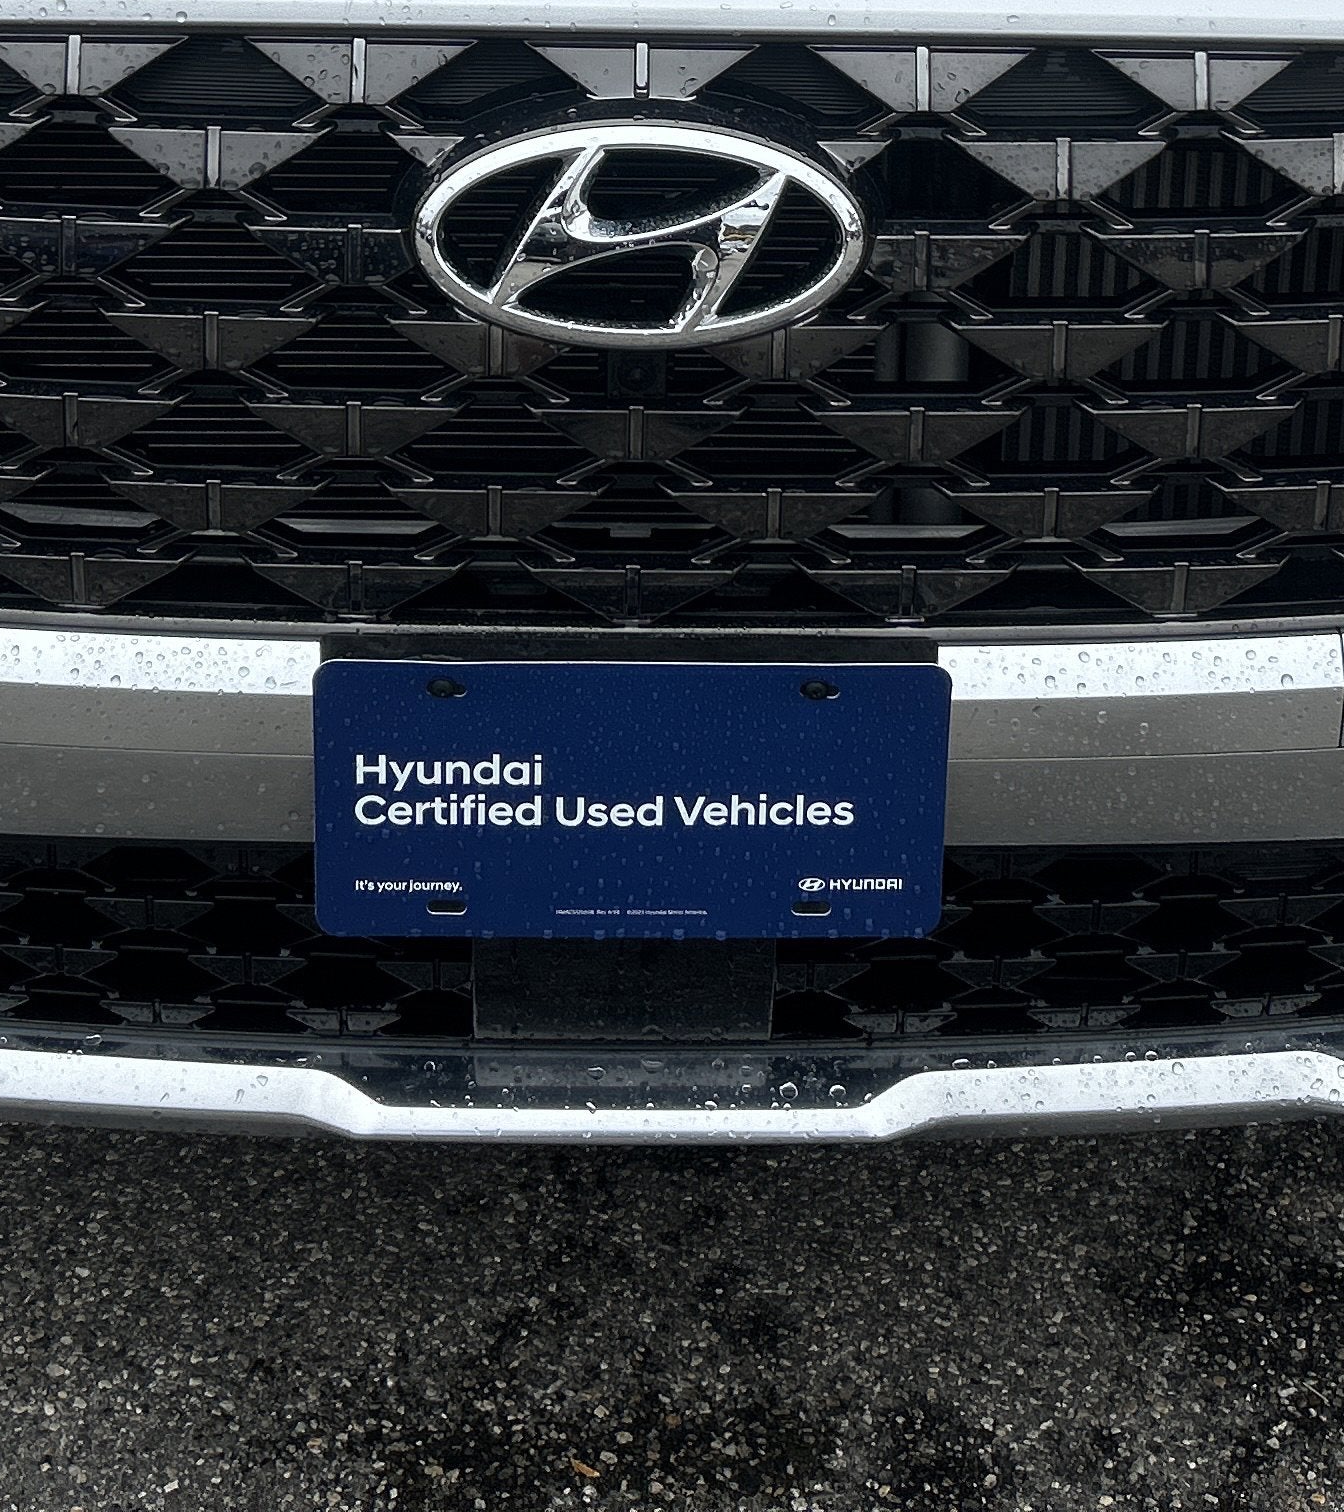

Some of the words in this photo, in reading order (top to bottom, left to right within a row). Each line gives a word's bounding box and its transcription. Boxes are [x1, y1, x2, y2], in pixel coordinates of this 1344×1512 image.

[355, 753, 543, 792] Hyundai
[354, 793, 542, 827] Certified
[555, 794, 664, 827] Used
[673, 793, 856, 827] Vehicles
[355, 879, 375, 891] It's
[376, 881, 408, 893] your
[408, 879, 463, 893] journey.
[829, 878, 903, 891] HYUNDAI
